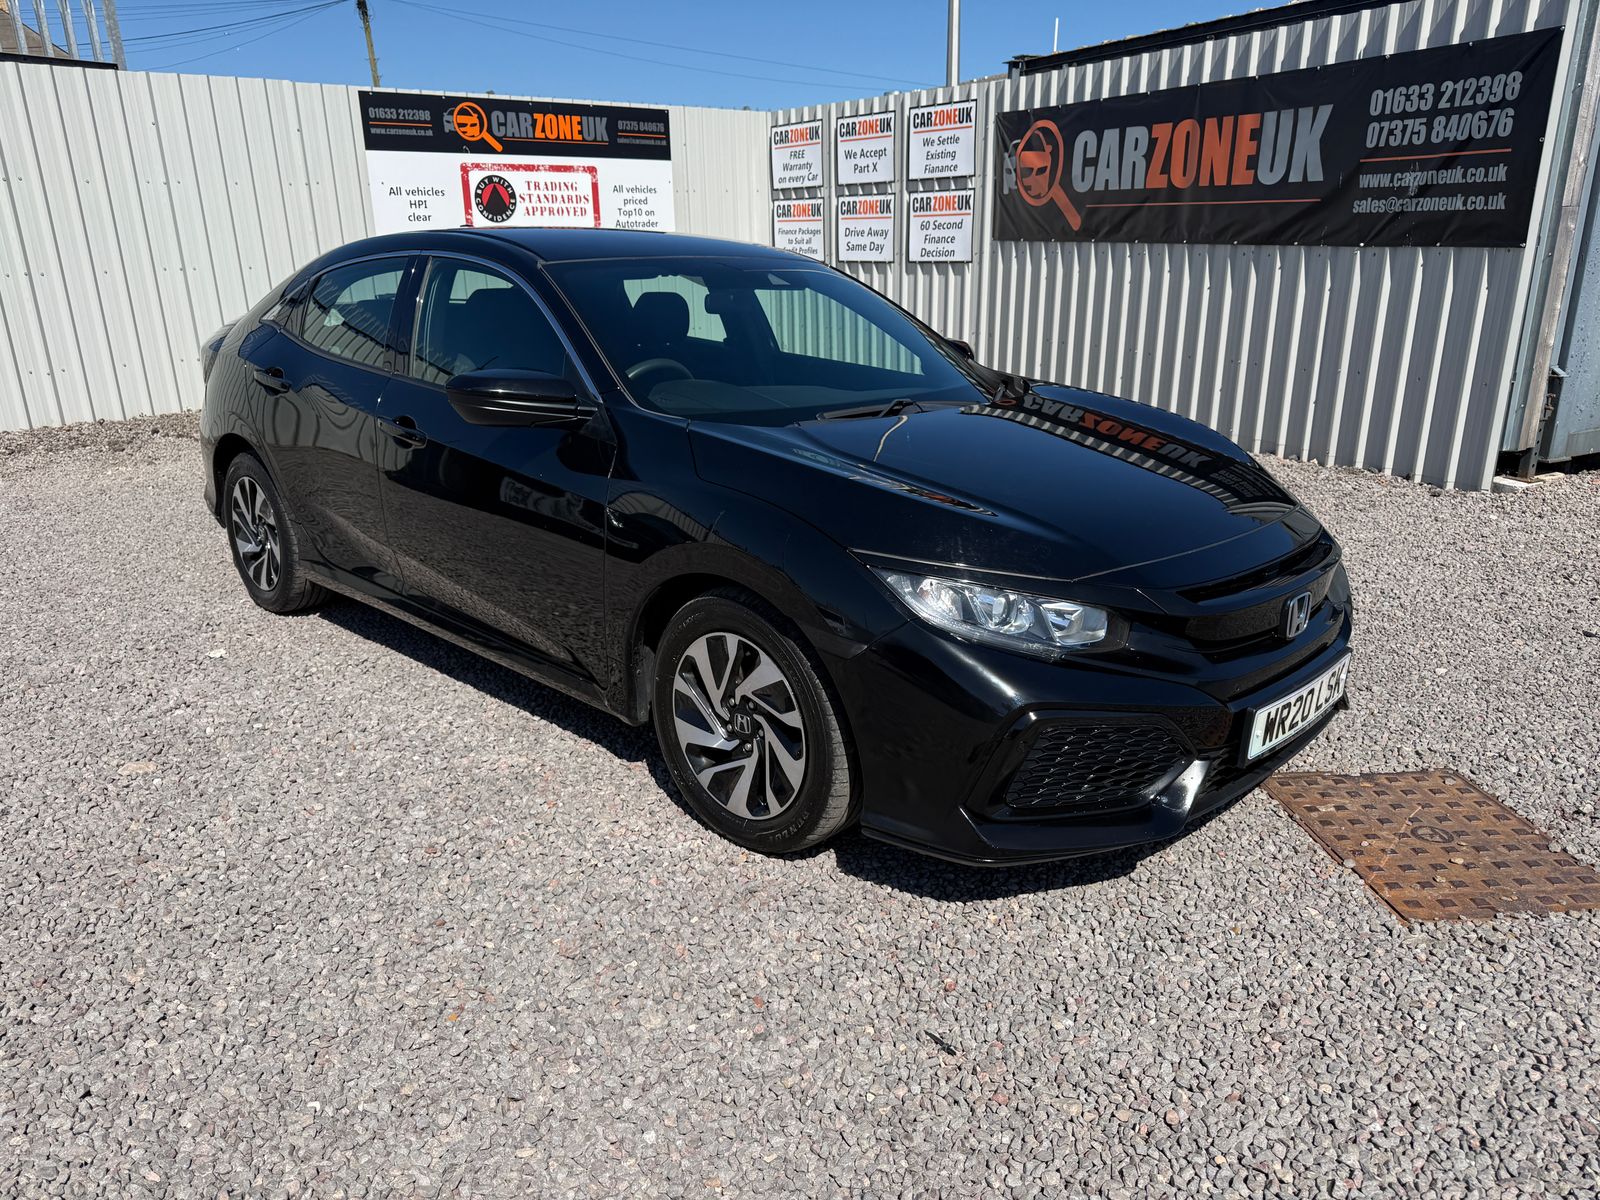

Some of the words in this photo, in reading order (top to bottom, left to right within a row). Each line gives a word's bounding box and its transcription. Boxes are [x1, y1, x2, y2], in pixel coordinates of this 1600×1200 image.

[1370, 84, 1435, 116] 01633
[1437, 71, 1523, 109] 212398
[368, 107, 397, 120] 01633
[398, 108, 431, 121] 212398
[913, 107, 972, 129] CARZONEUK
[491, 110, 609, 142] CARZONEUK
[839, 117, 892, 137] CARZONEUK
[1366, 117, 1425, 148] 07375
[1430, 109, 1515, 141] 840676
[773, 125, 820, 145] CARZONEUK
[922, 137, 935, 147] We
[937, 134, 960, 145] Settle
[844, 150, 858, 160] We
[859, 147, 887, 161] Accept
[1072, 104, 1333, 193] CARZONEUK
[789, 150, 806, 160] FREE
[926, 149, 957, 161] Existing
[782, 162, 813, 174] Warranty
[853, 164, 870, 174] Part
[871, 162, 878, 172] X
[778, 176, 787, 184] on
[788, 174, 806, 185] every
[807, 173, 819, 181] Car
[1359, 164, 1508, 188] www.carzoneuk.co.uk
[388, 186, 402, 196] All
[404, 186, 446, 197] vehicles
[476, 176, 490, 196] BUY
[492, 176, 513, 195] WITH
[525, 180, 578, 192] TRADING
[612, 184, 623, 194] All
[624, 185, 657, 195] vehicles
[409, 199, 428, 209] HPI
[518, 193, 590, 205] STANDARDS
[623, 196, 649, 207] priced
[912, 194, 971, 213] CARZONEUK
[1352, 193, 1507, 214] sales@carzoneuk.co.uk
[475, 197, 516, 222] CONFIDENCE
[523, 206, 588, 217] APPROVED
[617, 207, 643, 218] Top10
[776, 203, 822, 218] CARZONEUK
[840, 199, 892, 216] CARZONEUK
[407, 211, 432, 222] clear
[615, 219, 659, 229] Autotrader
[920, 221, 931, 231] 60
[932, 219, 963, 231] Second
[778, 227, 797, 235] Finance
[798, 227, 822, 237] Packages
[844, 227, 865, 237] Drive
[867, 227, 889, 240] Away
[794, 237, 805, 245] Suit
[805, 236, 813, 244] all
[924, 235, 956, 245] Finance
[799, 246, 818, 255] Profiles
[846, 242, 867, 252] Same
[870, 241, 884, 254] Day
[920, 247, 955, 258] Decision
[1262, 687, 1315, 747] WR20
[1314, 661, 1347, 715] LSK
